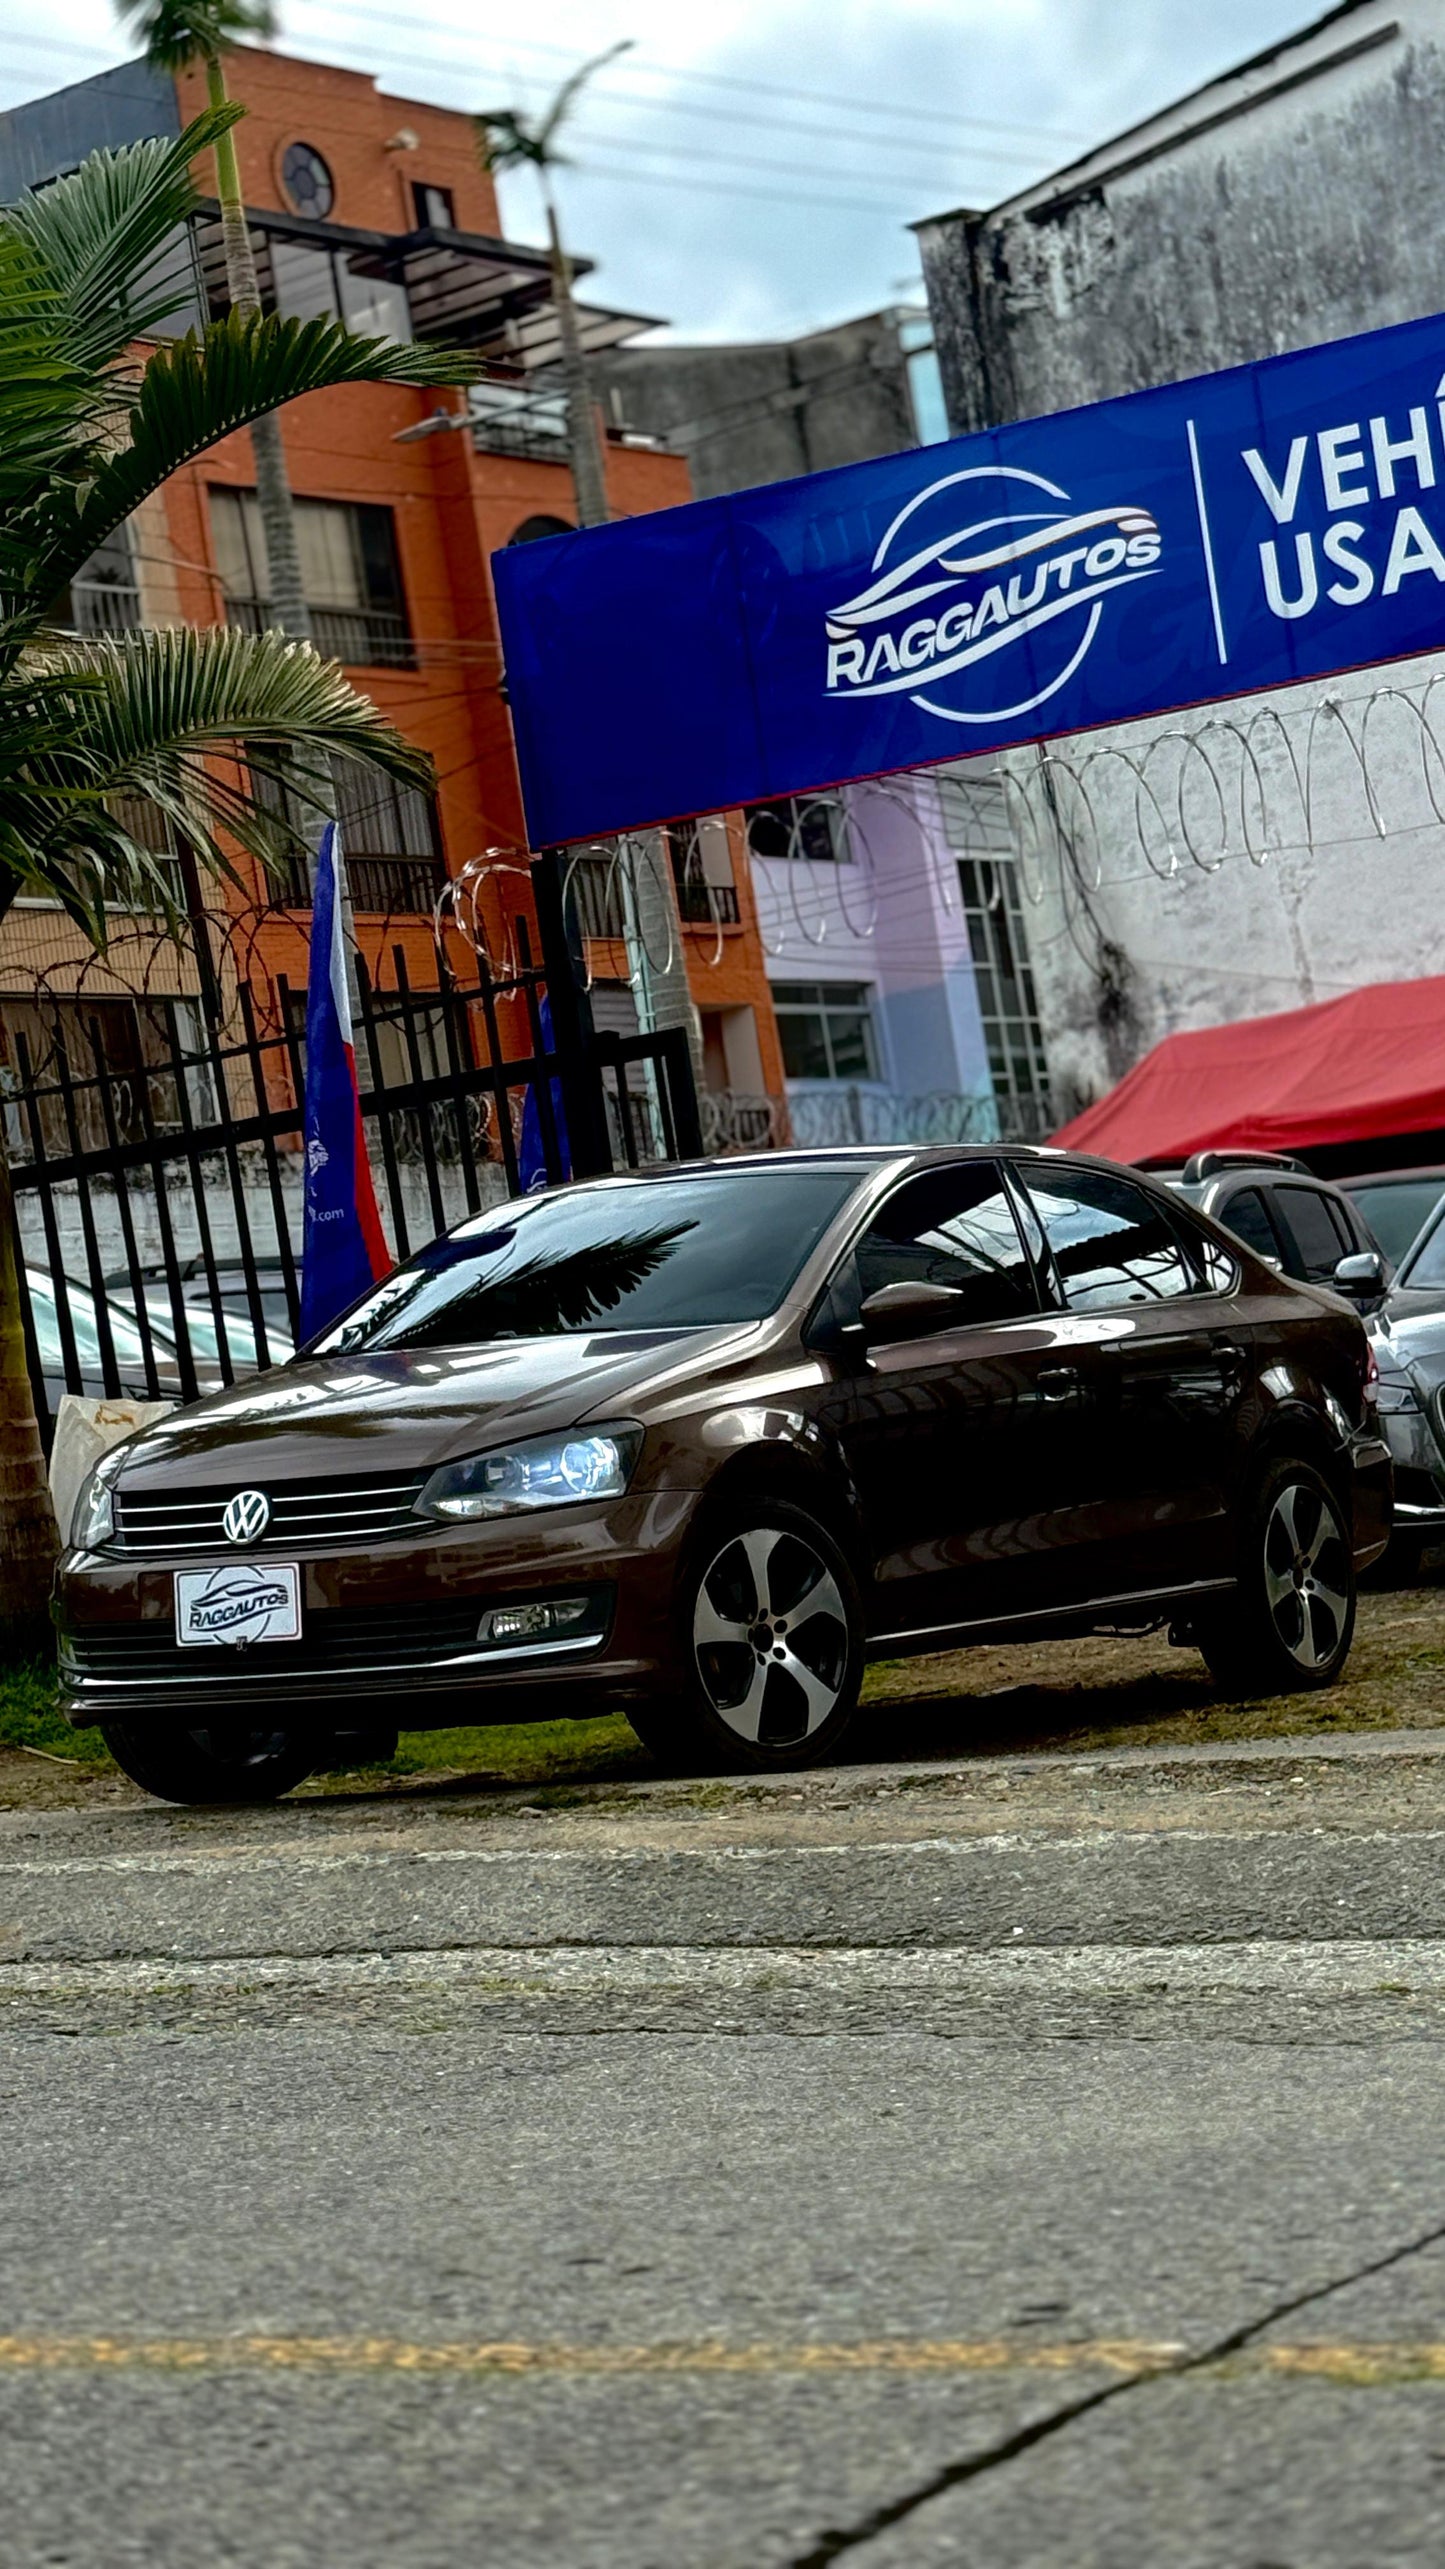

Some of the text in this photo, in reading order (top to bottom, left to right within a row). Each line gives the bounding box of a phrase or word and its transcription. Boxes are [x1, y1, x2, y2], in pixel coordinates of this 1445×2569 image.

[826, 533, 1162, 688] RAGGAUTOS
[308, 1205, 345, 1223] .com
[189, 1593, 289, 1628] RAGGAUTOS
